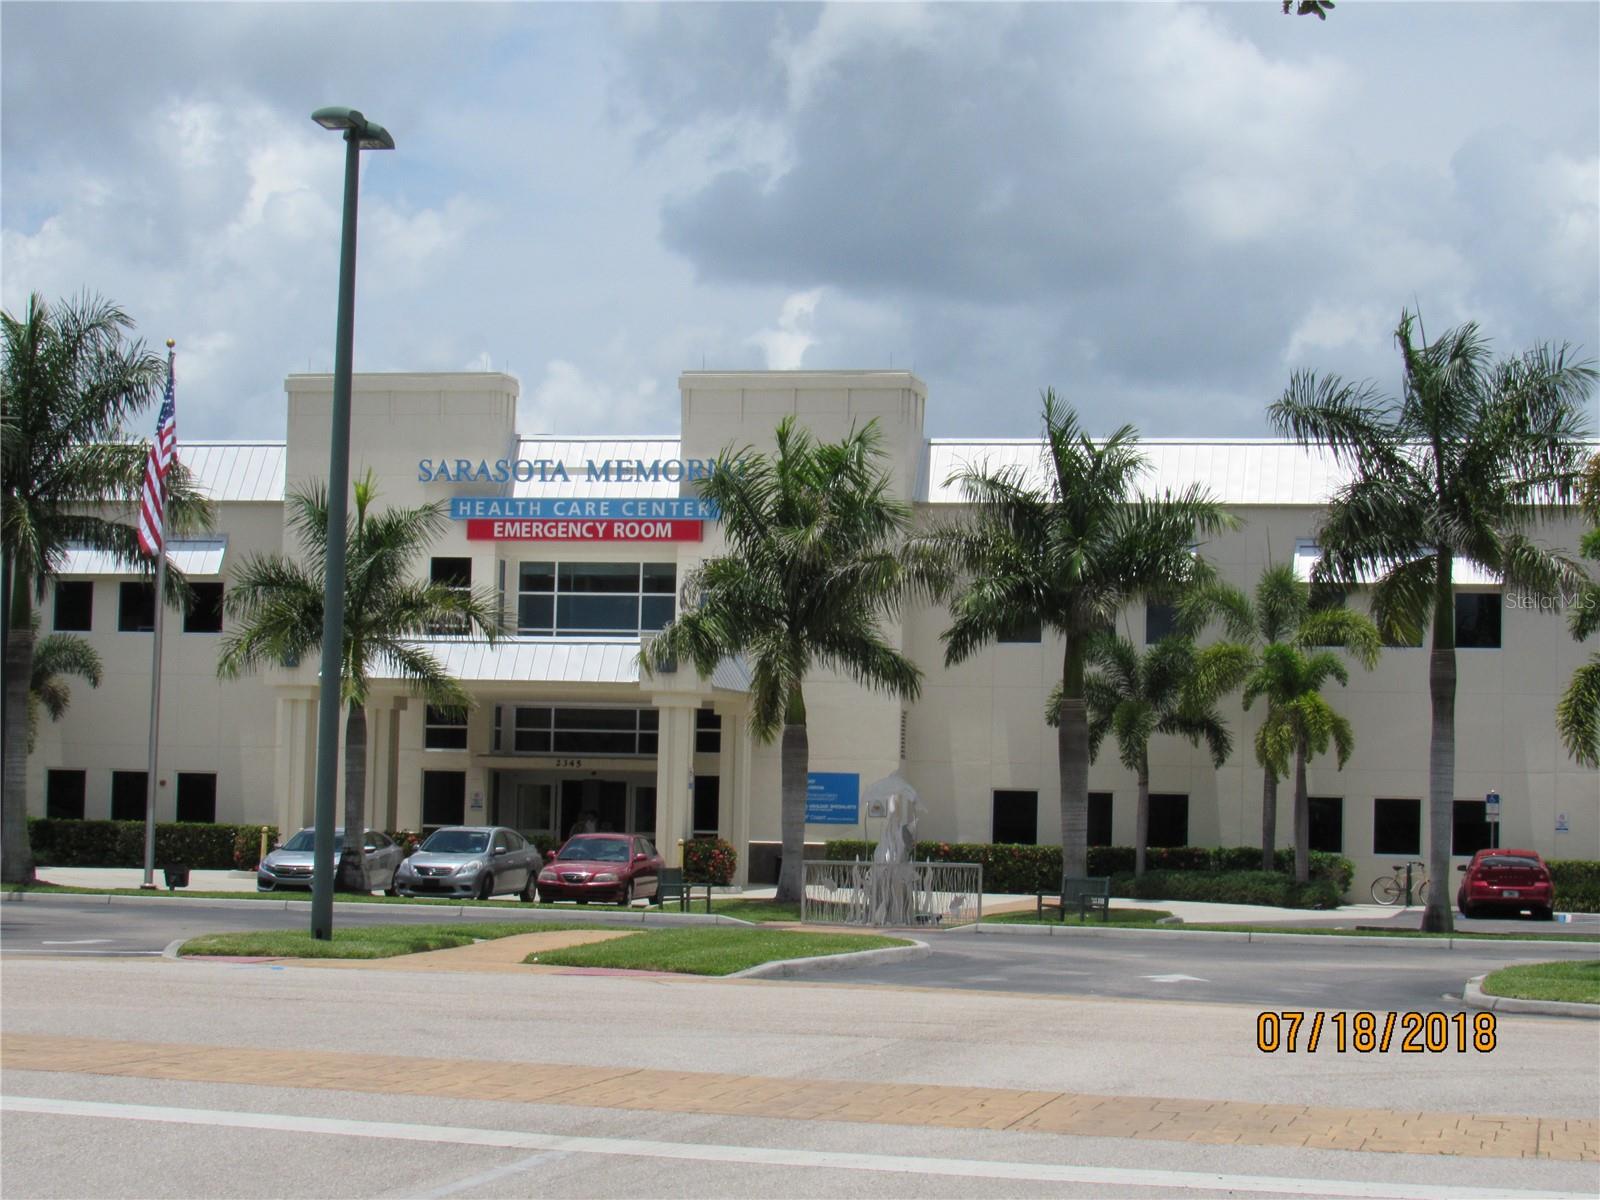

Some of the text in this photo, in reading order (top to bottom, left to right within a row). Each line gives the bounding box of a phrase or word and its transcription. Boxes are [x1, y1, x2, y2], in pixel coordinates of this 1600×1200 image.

[418, 459, 747, 483] SARASOTA MEMORI
[459, 501, 710, 517] HEALTH CARE CENTER
[493, 522, 672, 538] EMERGENCY ROOM
[555, 759, 582, 768] 2345
